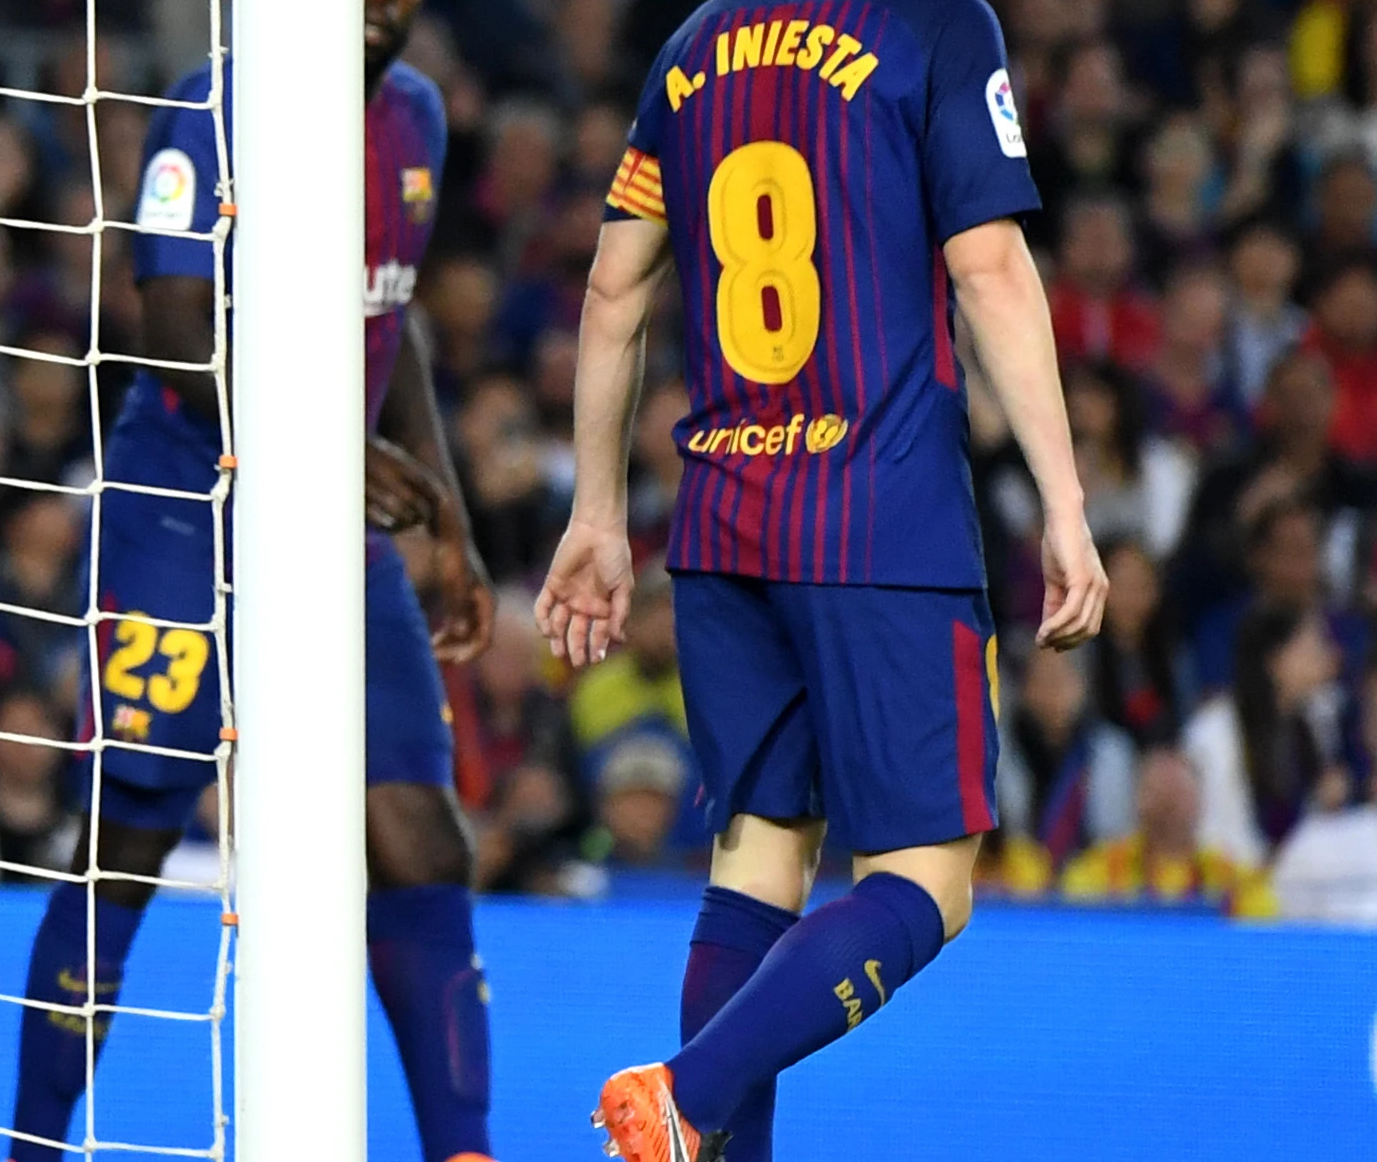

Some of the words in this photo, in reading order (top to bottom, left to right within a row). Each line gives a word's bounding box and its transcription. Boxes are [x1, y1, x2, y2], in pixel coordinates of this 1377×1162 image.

[666, 67, 707, 113] A.
[715, 20, 879, 102] INIESTA
[708, 140, 821, 385] 8
[688, 413, 803, 456] unicef
[103, 610, 210, 714] 23
